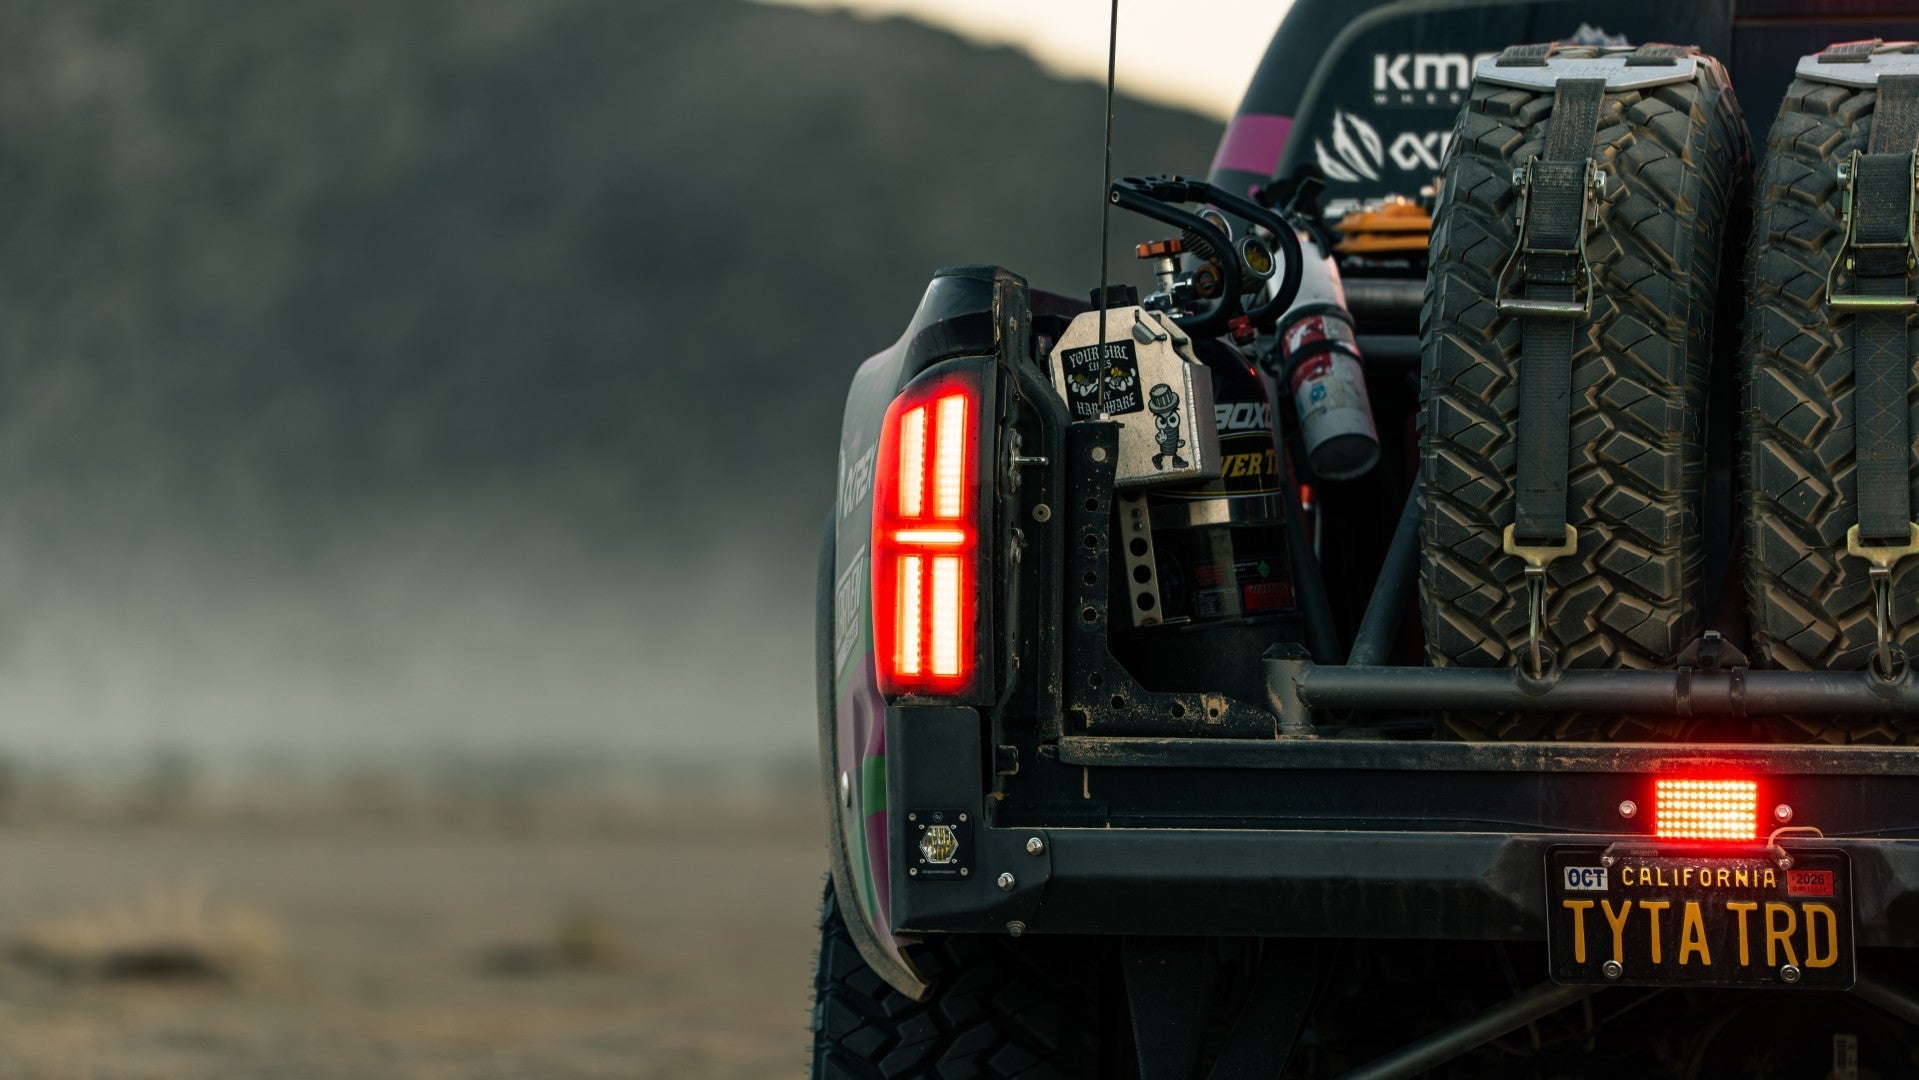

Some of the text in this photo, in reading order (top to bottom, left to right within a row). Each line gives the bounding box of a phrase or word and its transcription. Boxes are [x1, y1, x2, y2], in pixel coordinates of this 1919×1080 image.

[1374, 53, 1498, 90] KM
[1374, 93, 1462, 104] WHEE
[1069, 346, 1100, 368] YOUR
[1568, 868, 1605, 888] OCT
[1622, 867, 1777, 888] CALIFORNIA
[1796, 873, 1825, 885] 2026
[1563, 900, 1839, 968] TYTA TRD
